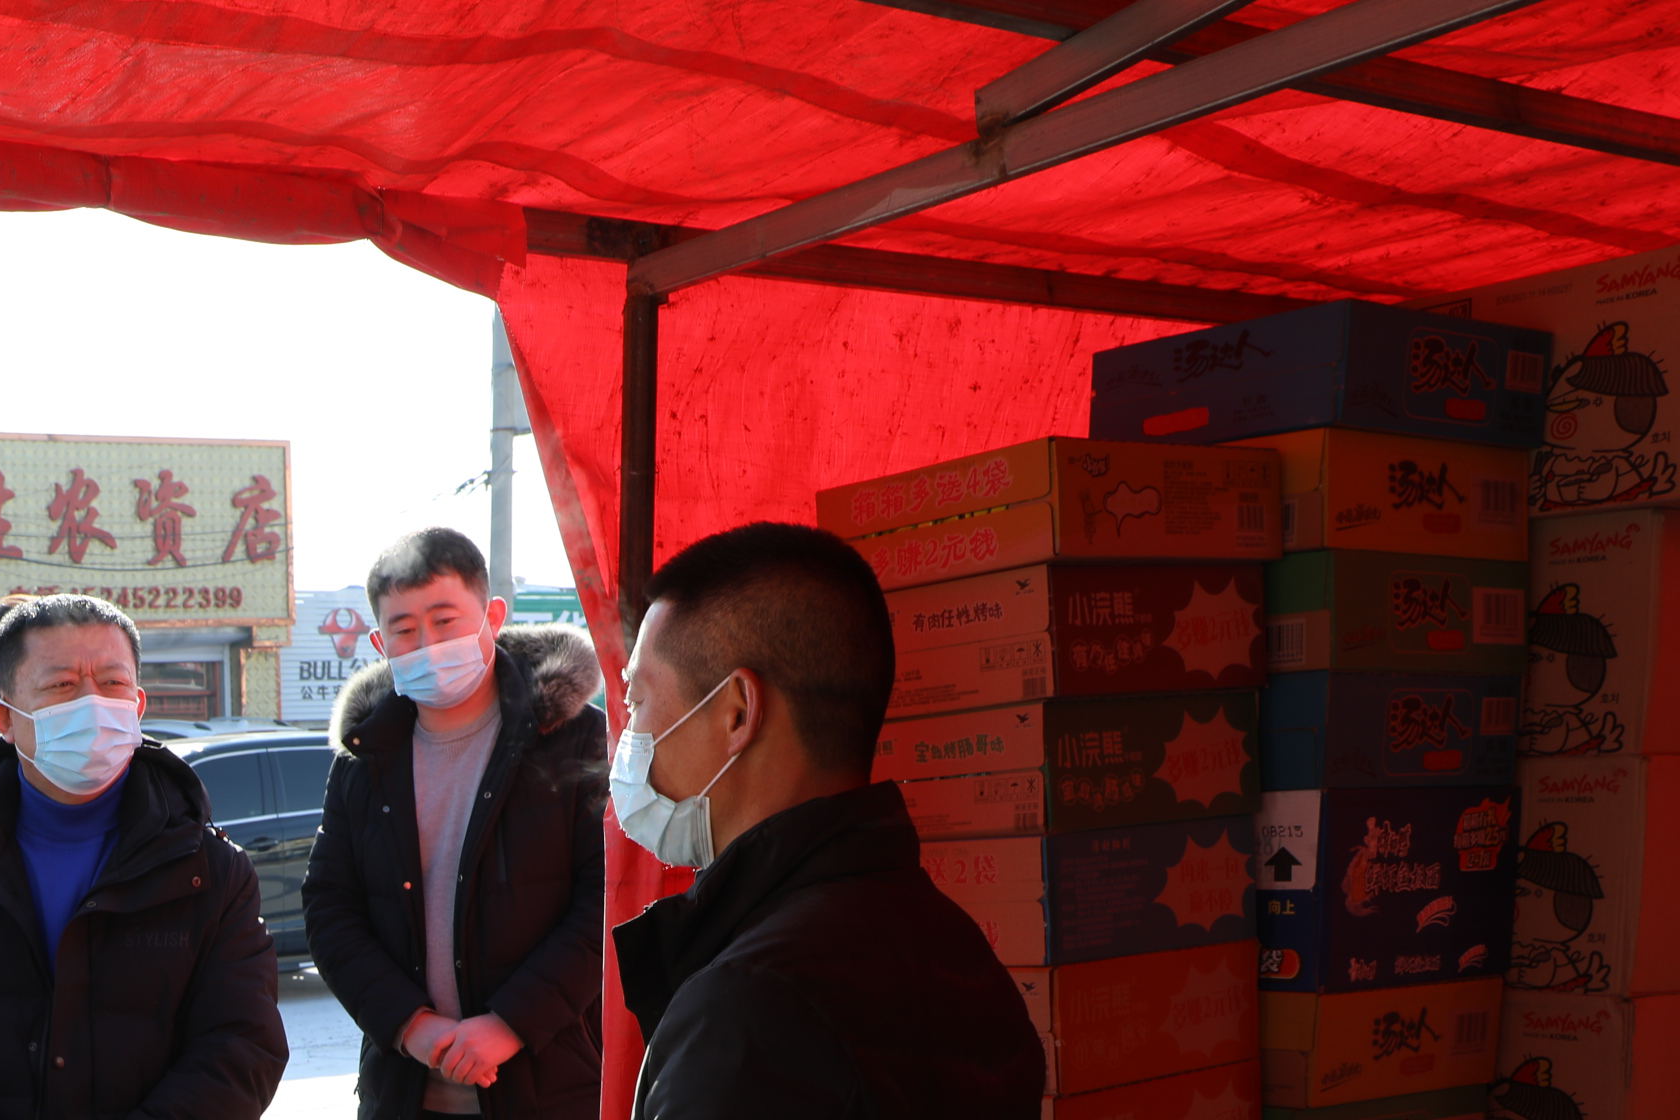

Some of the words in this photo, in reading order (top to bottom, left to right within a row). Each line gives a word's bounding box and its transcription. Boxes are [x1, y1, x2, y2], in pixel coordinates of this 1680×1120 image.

[1412, 337, 1495, 394] 汤达人
[851, 456, 1014, 525] 箱箱多送4袋
[1389, 460, 1466, 509] 汤达人
[1550, 532, 1633, 556] SAMYANG
[1068, 592, 1134, 626] 小浣熊
[1392, 576, 1467, 630] 汤达人
[299, 660, 346, 681] BULL
[1390, 694, 1471, 751] 汤达人
[1538, 774, 1620, 795] SAMYANG
[1268, 900, 1296, 916] 向上
[1372, 1005, 1441, 1061] 汤达人
[1523, 1011, 1604, 1035] SAMYANG
